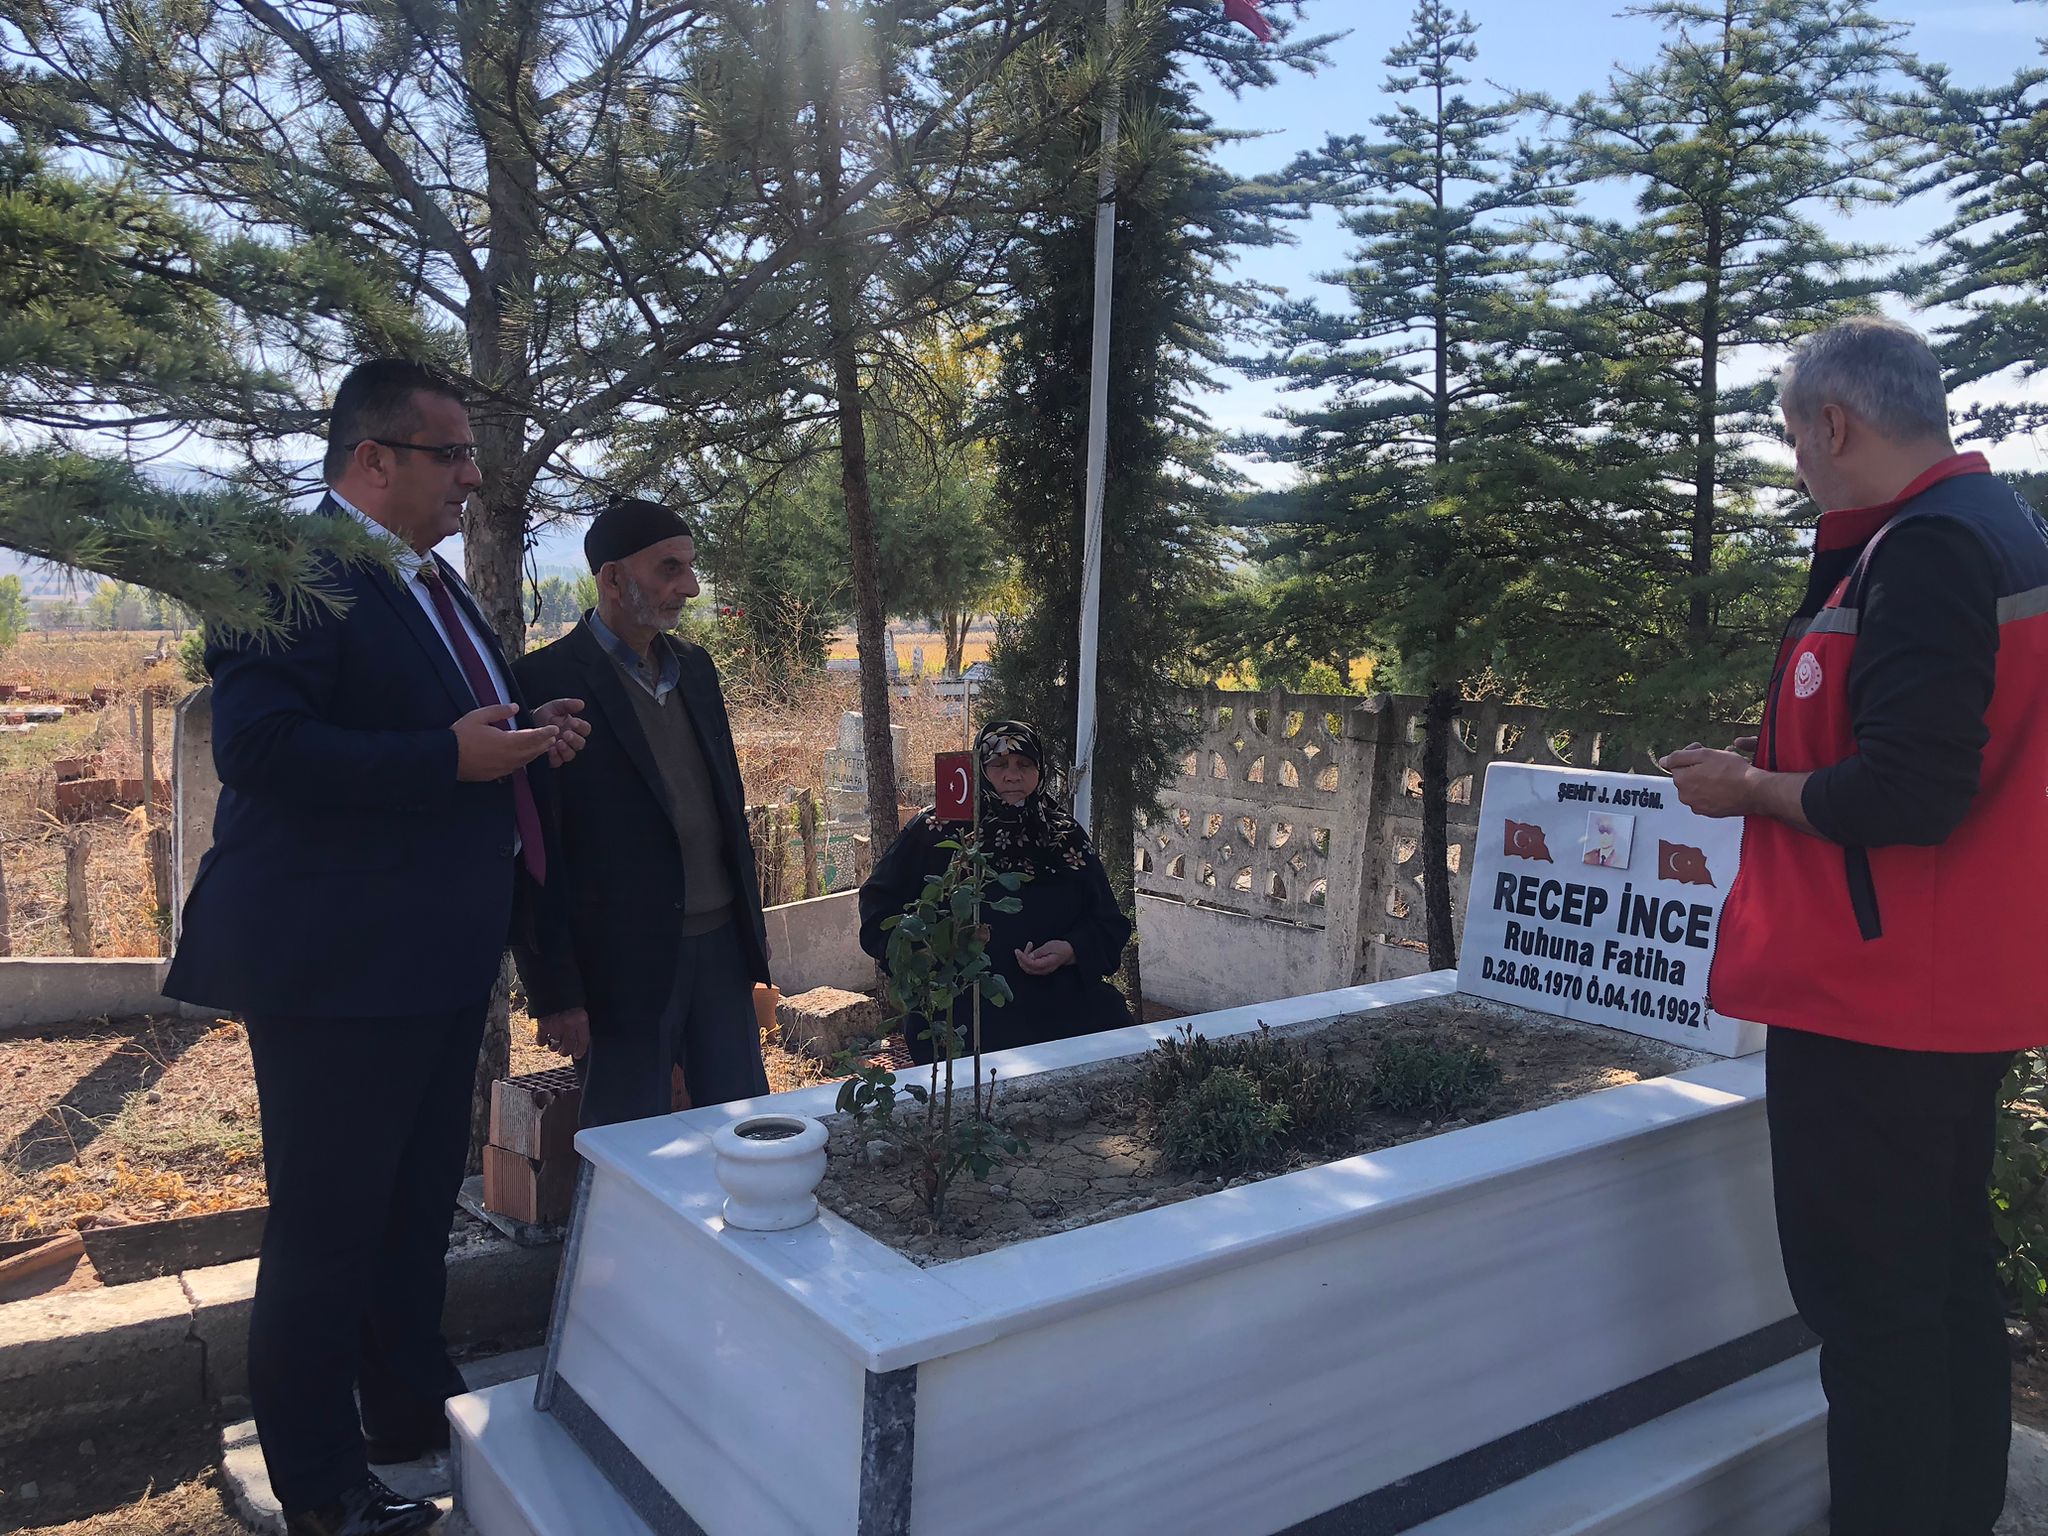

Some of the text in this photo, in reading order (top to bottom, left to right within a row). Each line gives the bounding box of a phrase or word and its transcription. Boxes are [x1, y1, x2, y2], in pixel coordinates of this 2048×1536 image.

[1558, 781, 1664, 809] ŞEHİT J. ASTĞM.
[1493, 871, 1713, 949] RECEP İNCE
[1504, 921, 1686, 986] Ruhuna Fatiha
[1482, 956, 1701, 1028] D.28.08.1970 Ö.04.10.1992
